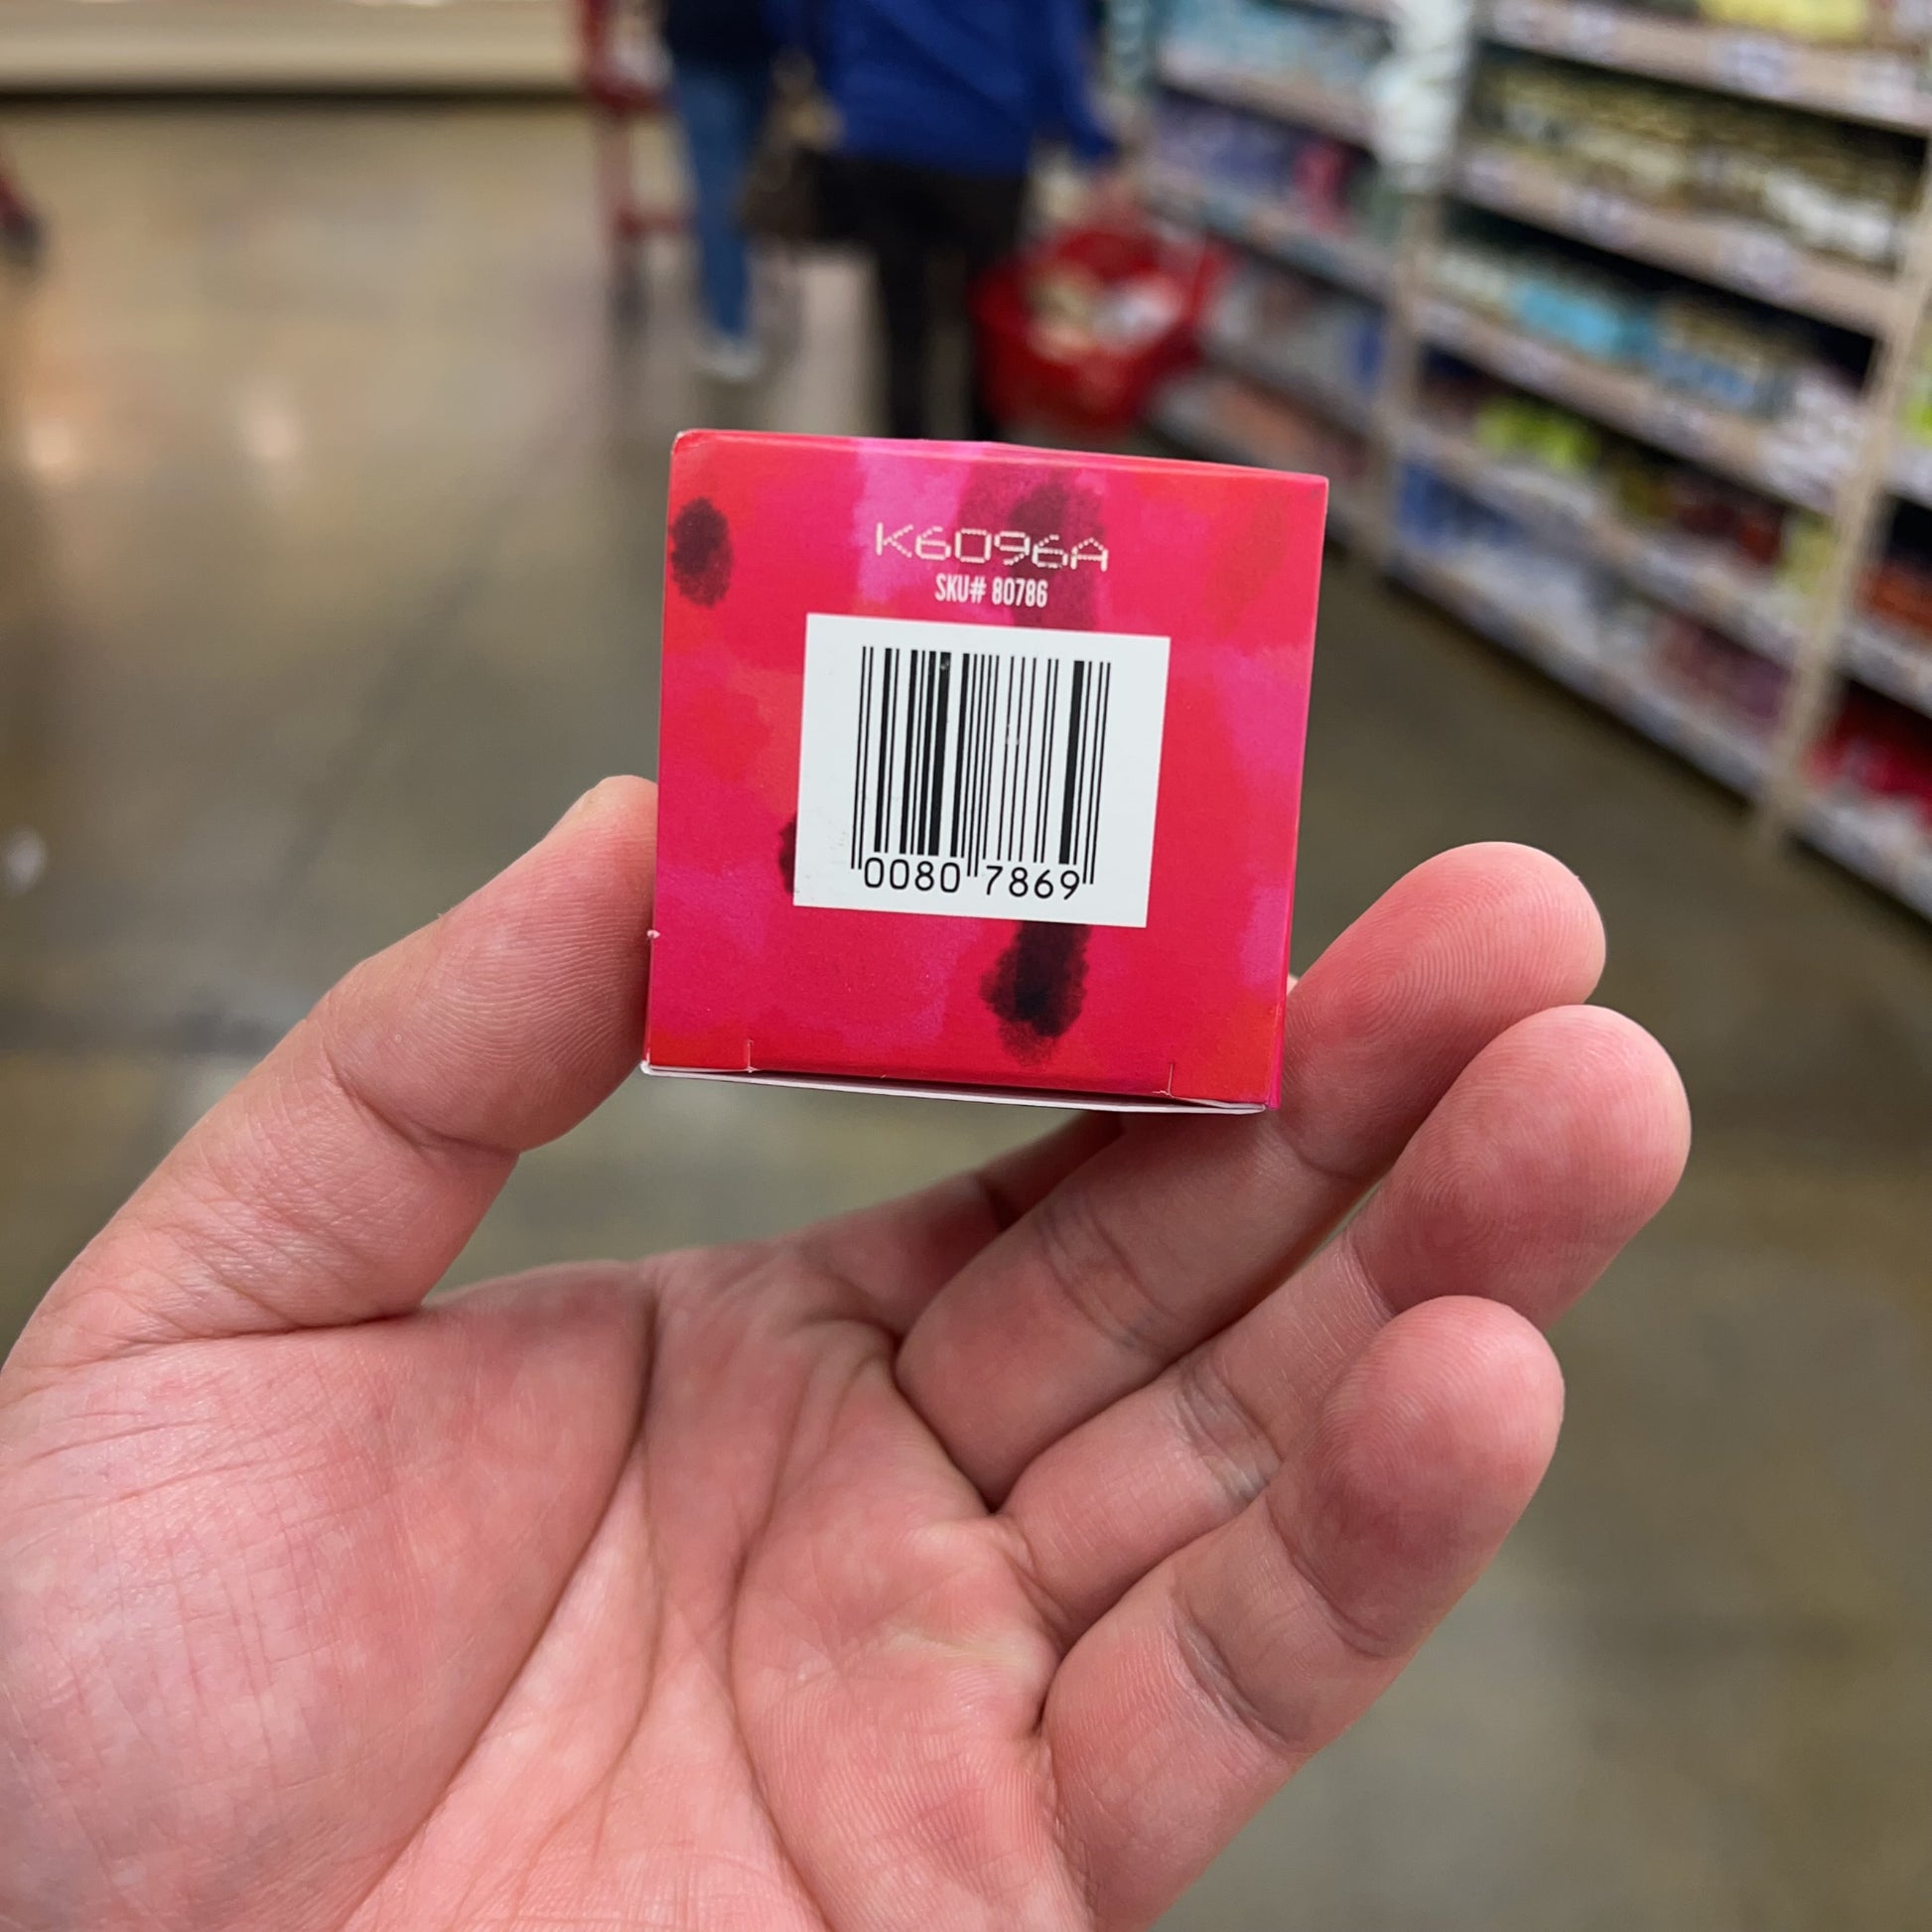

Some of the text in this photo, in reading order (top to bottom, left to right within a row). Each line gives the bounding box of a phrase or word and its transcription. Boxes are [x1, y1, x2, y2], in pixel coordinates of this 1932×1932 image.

[875, 521, 1108, 572] K6096A
[935, 573, 1048, 608] SKU# 80786
[864, 857, 1080, 899] 0080 7869
